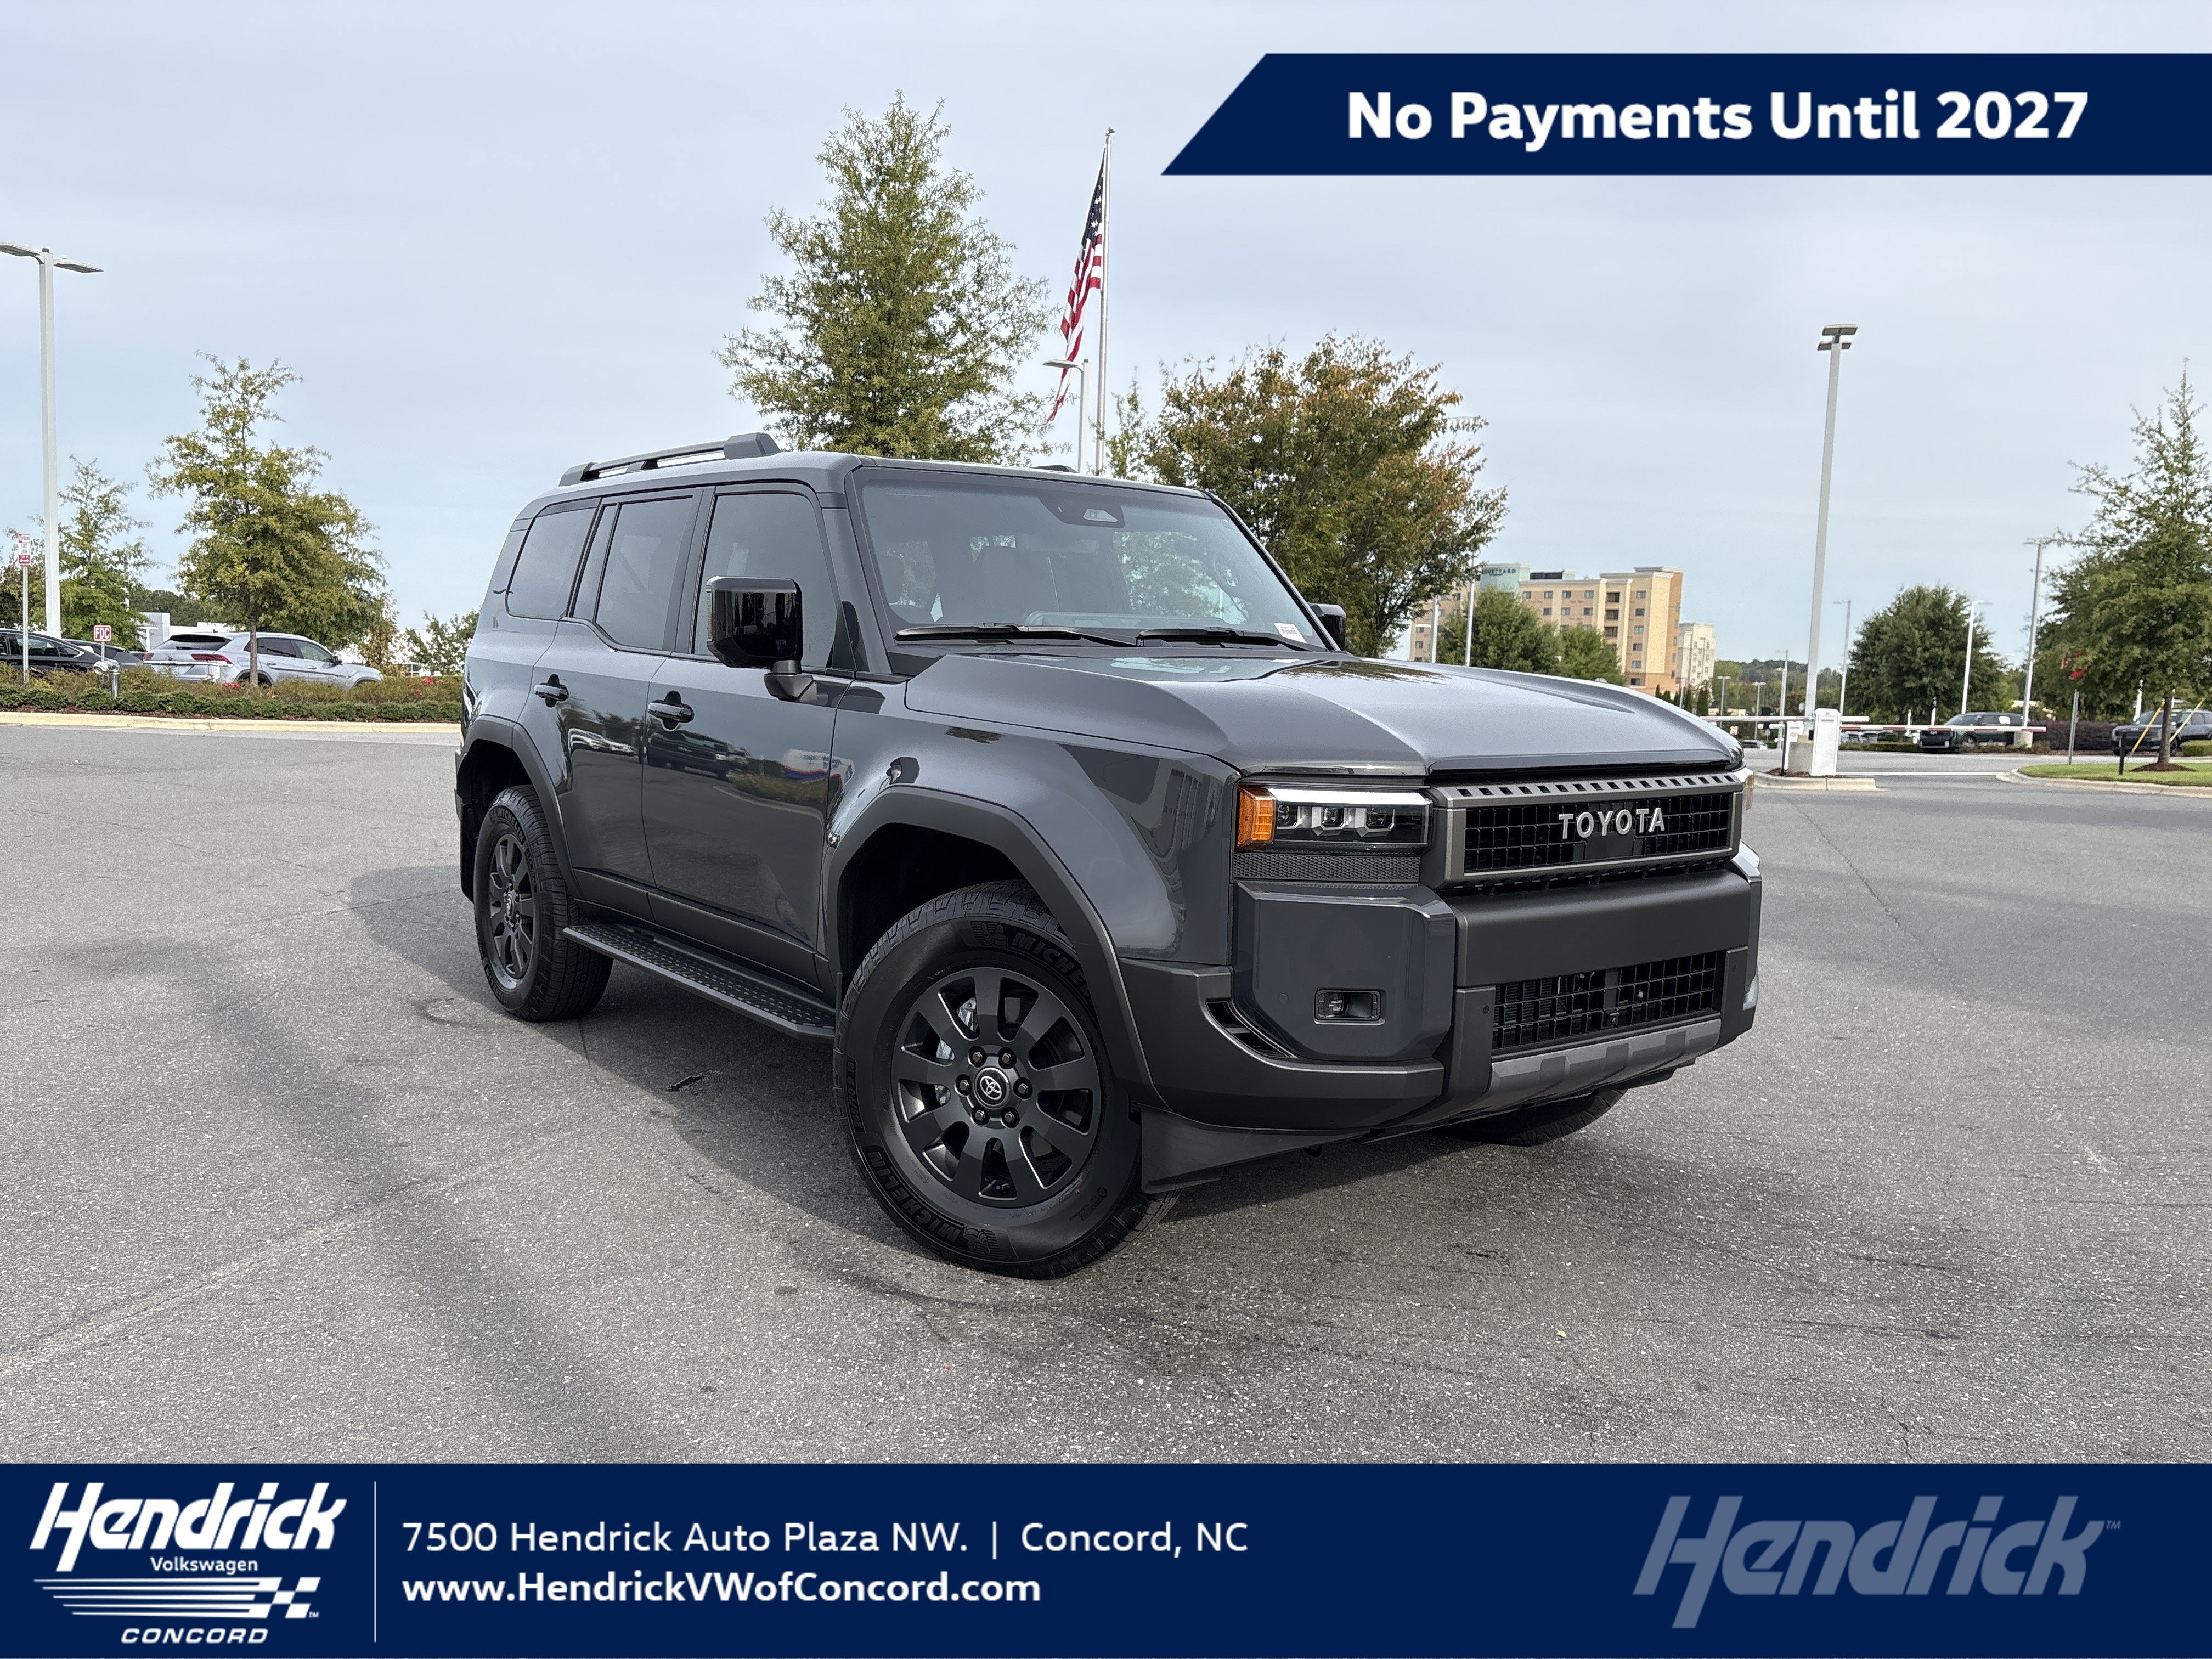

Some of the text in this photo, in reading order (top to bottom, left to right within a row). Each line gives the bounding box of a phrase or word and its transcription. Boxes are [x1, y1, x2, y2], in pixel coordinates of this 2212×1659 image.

[95, 627, 110, 639] FDC
[498, 808, 524, 842] MICHELIN
[1558, 807, 1665, 839] TOYOTA
[1012, 932, 1093, 1005] MICHEL
[866, 1151, 961, 1243] MICHELIN
